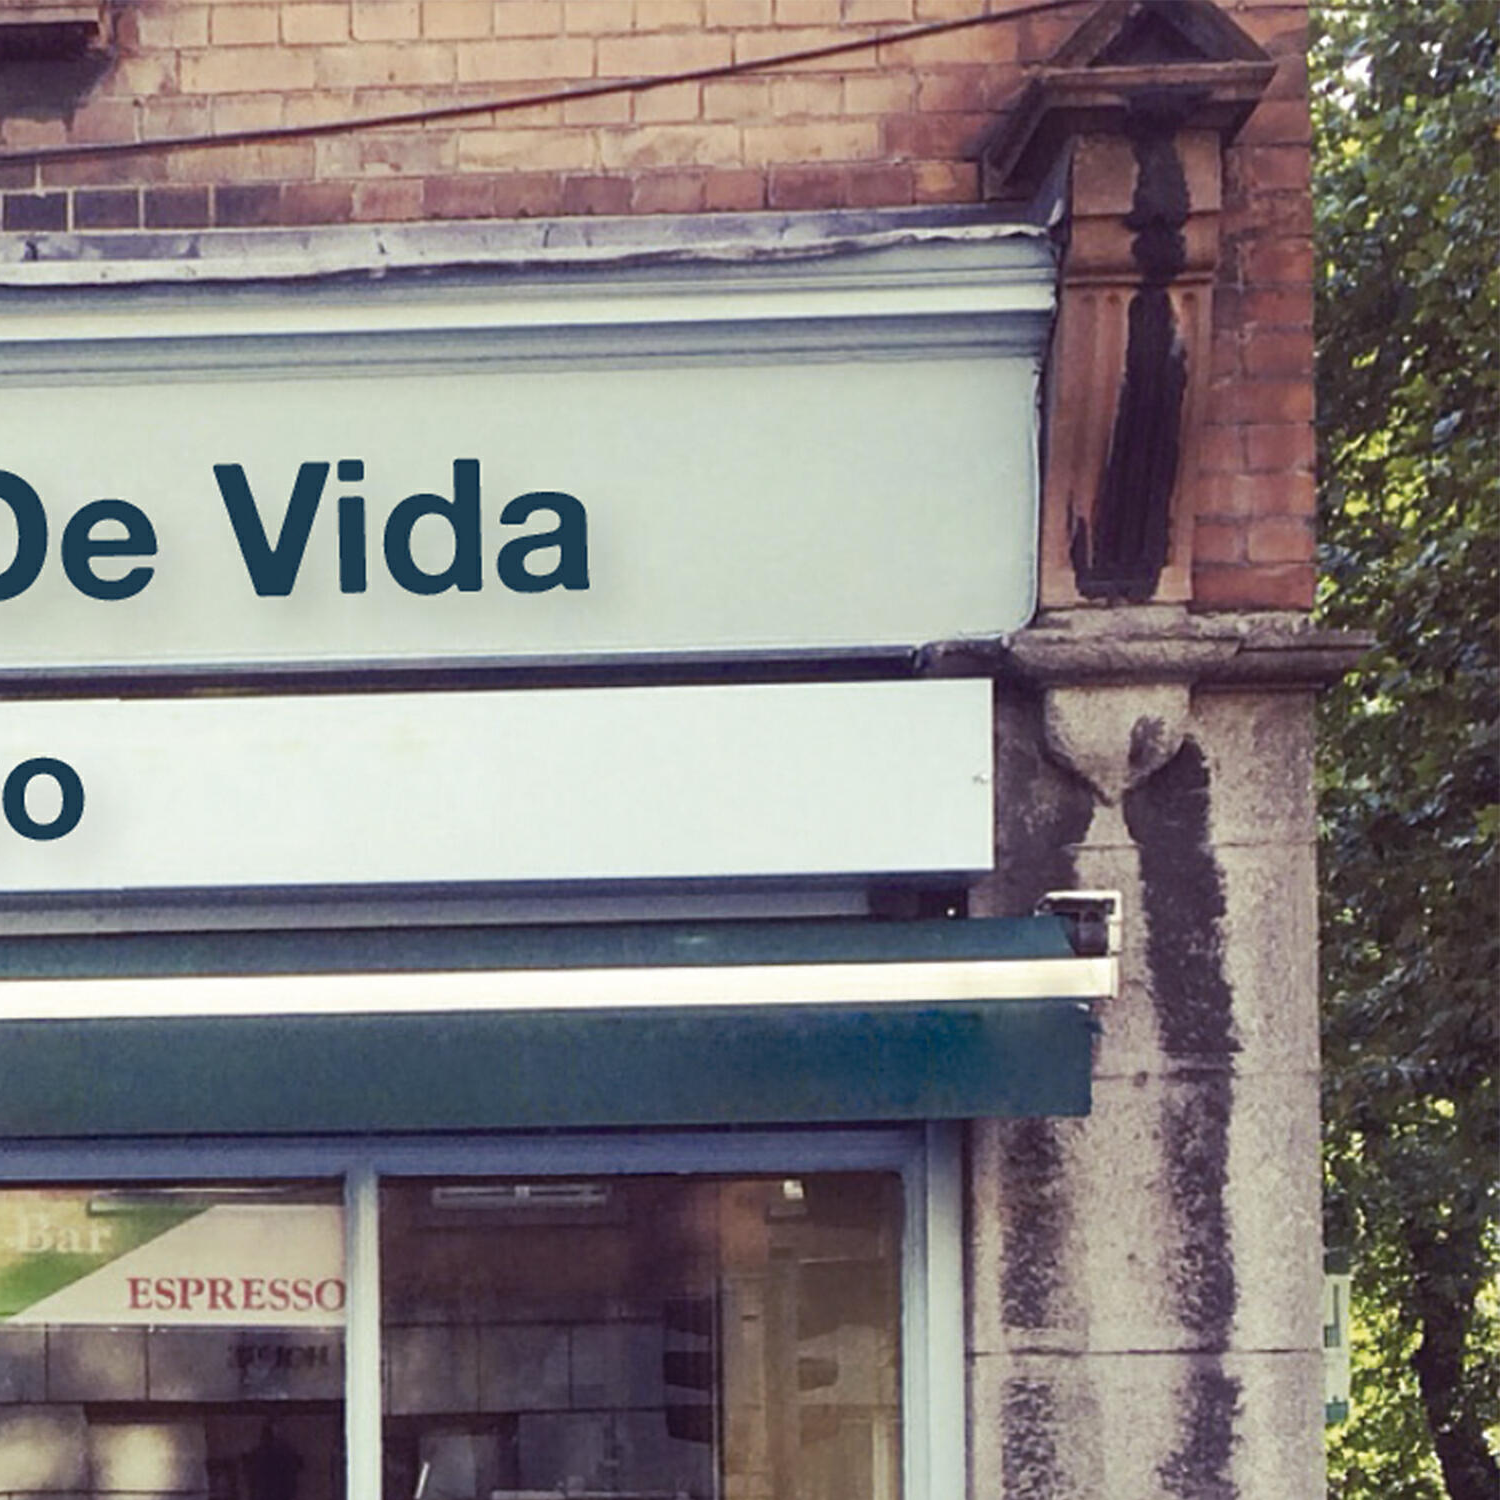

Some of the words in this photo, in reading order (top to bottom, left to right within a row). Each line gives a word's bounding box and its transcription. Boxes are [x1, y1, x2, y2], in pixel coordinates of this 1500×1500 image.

[212, 457, 591, 598] Vida
[5, 1206, 113, 1254] Bar
[126, 1275, 348, 1312] ESPRESSO
